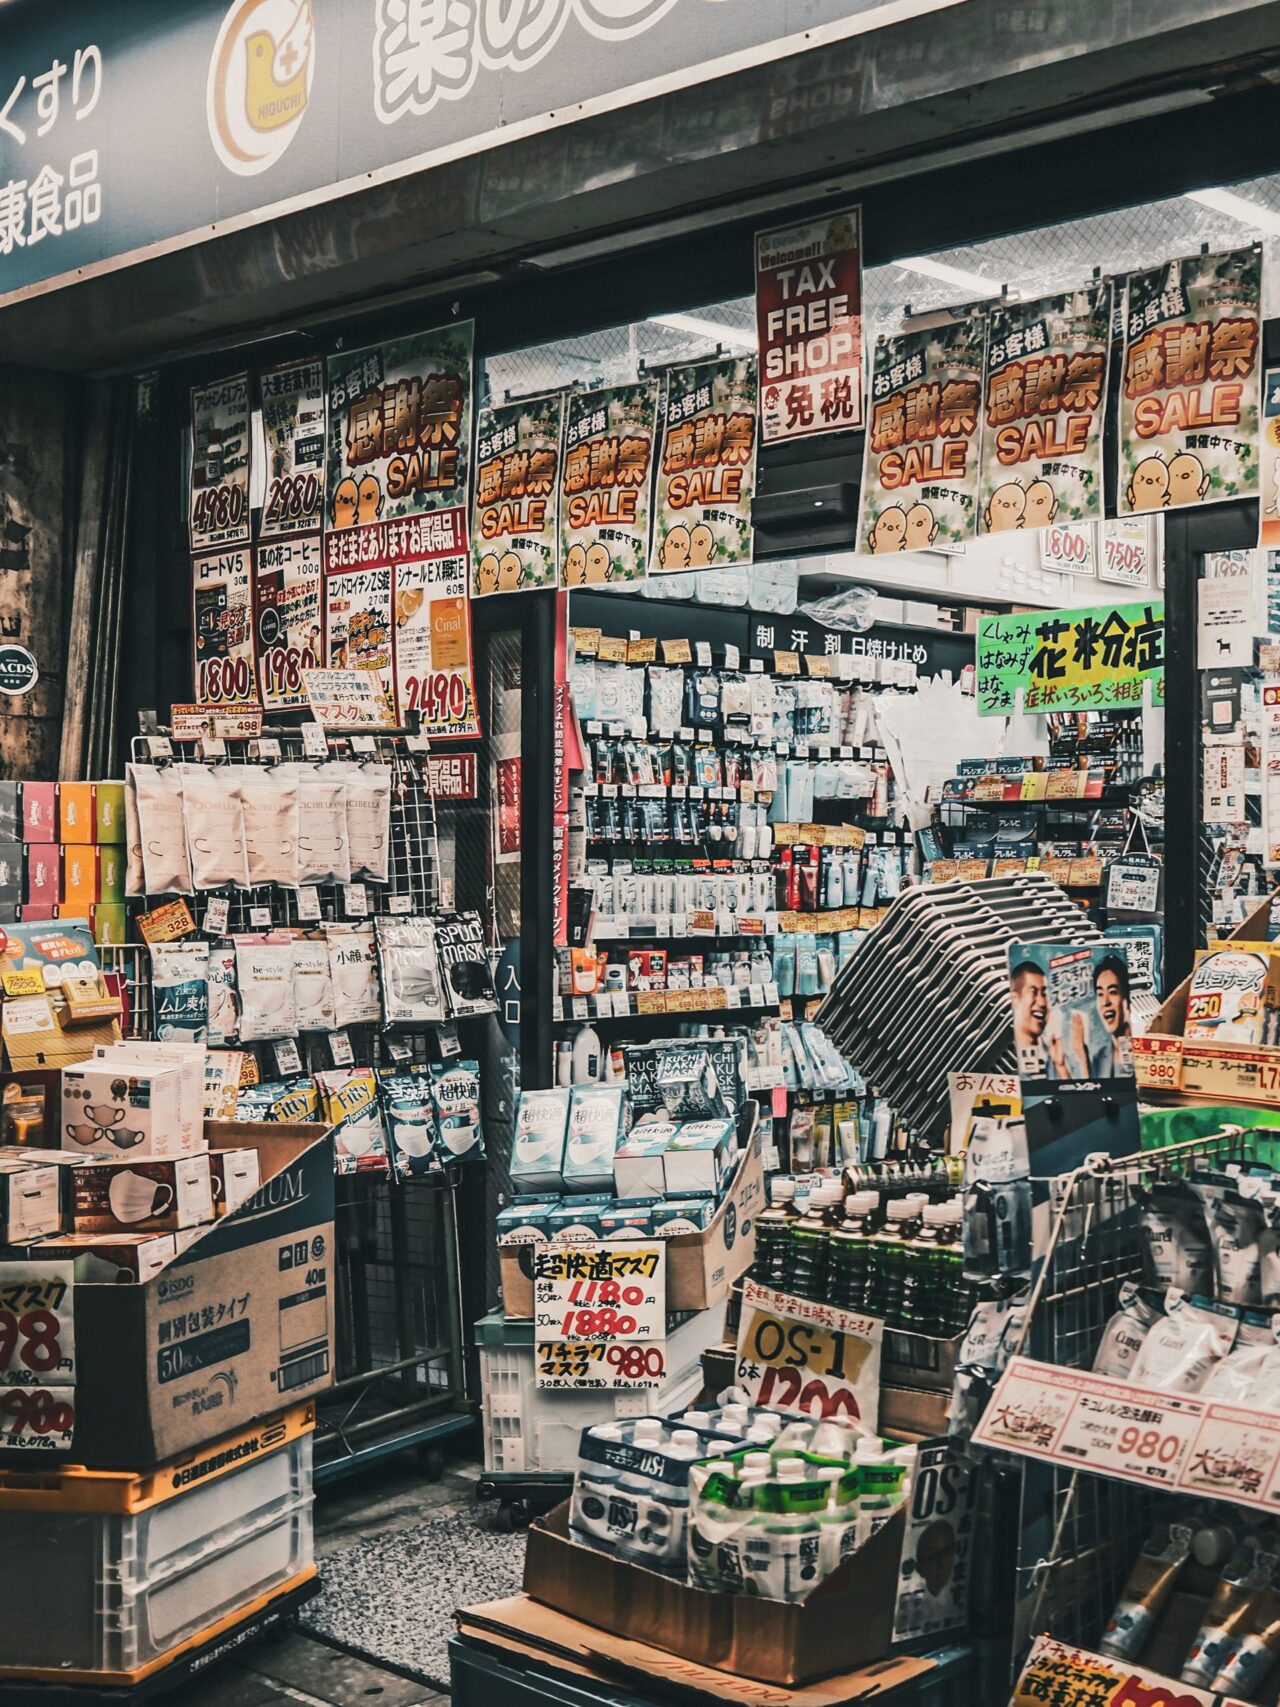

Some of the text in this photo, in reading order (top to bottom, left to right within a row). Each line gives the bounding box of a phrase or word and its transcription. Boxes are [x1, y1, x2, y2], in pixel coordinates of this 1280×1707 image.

[258, 91, 301, 121] HIGUCHI
[777, 259, 838, 299] TAX
[766, 294, 849, 341] FREE
[1130, 289, 1187, 335] お客様
[766, 333, 853, 378] SHOP
[990, 327, 1046, 366] お客様
[1125, 318, 1259, 399] 感謝祭
[331, 362, 381, 409] お客様
[874, 355, 922, 395] お客様
[986, 353, 1107, 428] 感謝祭
[347, 376, 462, 465] 感謝祭
[669, 387, 710, 421] お客様
[784, 374, 854, 429] 免税
[871, 380, 982, 453] 感謝祭
[1135, 384, 1244, 438] SALE
[479, 424, 516, 458] お客様
[567, 410, 607, 443] お客様
[663, 413, 756, 475] 感謝祭
[997, 415, 1092, 466] SALE
[387, 450, 457, 498] SALE
[478, 450, 558, 507] 感謝祭
[564, 436, 652, 496] 感謝祭
[880, 441, 968, 490] SALE
[193, 484, 243, 531] 4980
[266, 473, 318, 520] 2980
[569, 490, 638, 529] SALE
[668, 469, 743, 510] SALE
[329, 512, 461, 568] まだまだありますお買得品!
[482, 501, 547, 539] SALE
[201, 554, 243, 579] ロートV5
[298, 564, 319, 575] 100g
[1105, 538, 1145, 572] 7505
[435, 616, 461, 632] Cinal
[982, 623, 1031, 644] くしゃみ
[1029, 606, 1164, 680] 花粉症
[851, 637, 928, 665] 日焼け止め
[979, 646, 1032, 674] はなみず
[201, 657, 249, 701] 1800
[405, 673, 465, 717] 2490
[978, 676, 1004, 693] はな
[237, 721, 258, 731] 498
[316, 705, 360, 720] マスク
[167, 917, 189, 934] 328
[440, 926, 481, 945] SPUN
[443, 942, 486, 964] MASK
[505, 965, 521, 1024] 入口
[1193, 967, 1265, 992] 虫コナーズ
[1149, 1064, 1175, 1078] 980
[337, 1081, 370, 1111] Fitty
[535, 1250, 660, 1281] 超快適マスク
[158, 1292, 251, 1344] 個別包装タイプ
[537, 1343, 606, 1362] クチラク
[540, 1362, 589, 1376] マスク
[754, 1319, 845, 1379] OS-1
[1118, 1427, 1179, 1464] 980
